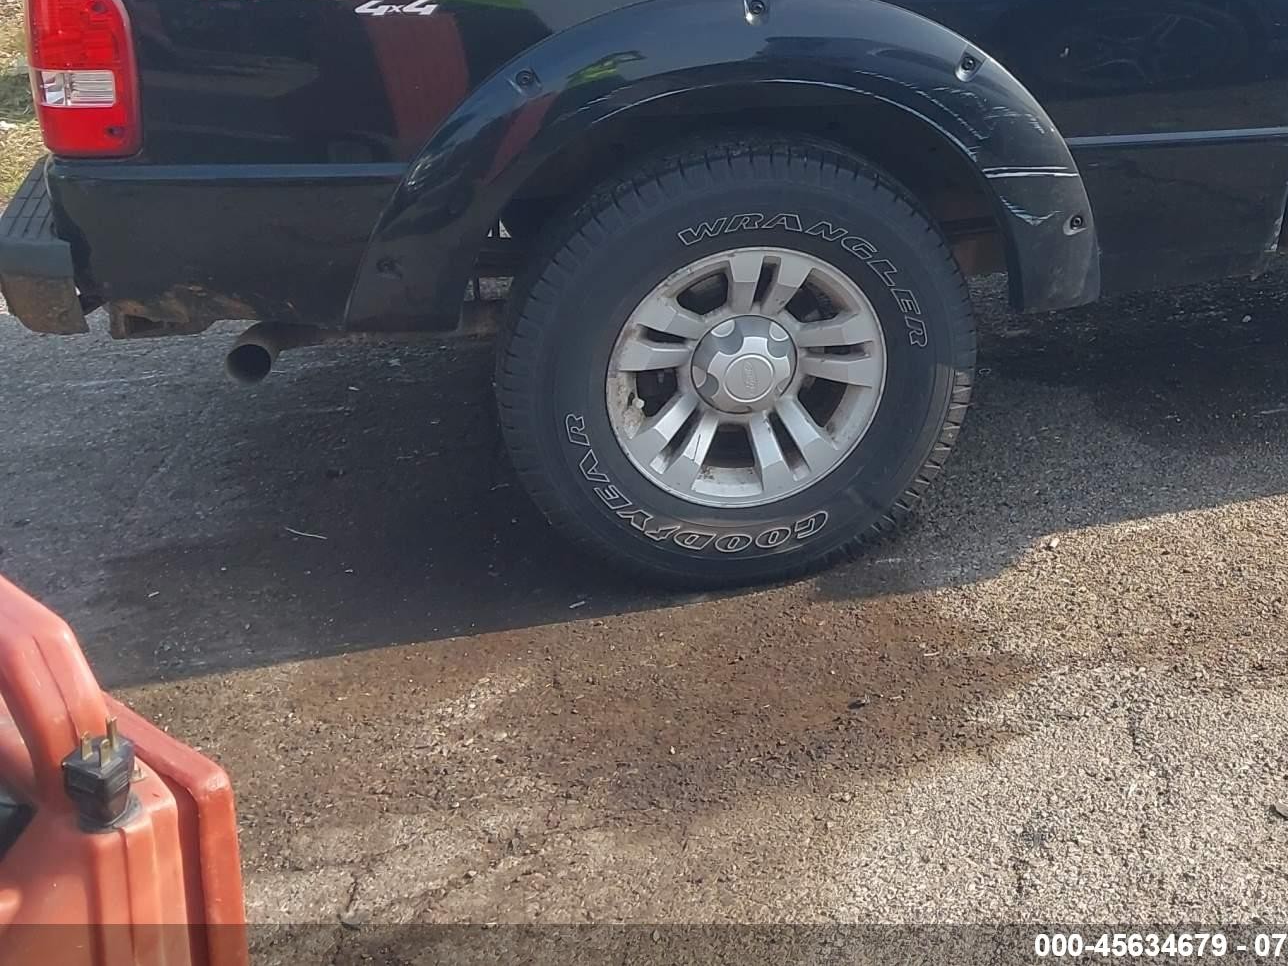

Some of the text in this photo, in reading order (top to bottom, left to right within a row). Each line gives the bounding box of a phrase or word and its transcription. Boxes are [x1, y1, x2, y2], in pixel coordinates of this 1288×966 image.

[354, 0, 440, 17] 4x4
[676, 212, 929, 348] WRANGLER
[564, 412, 830, 553] GOODYEAR
